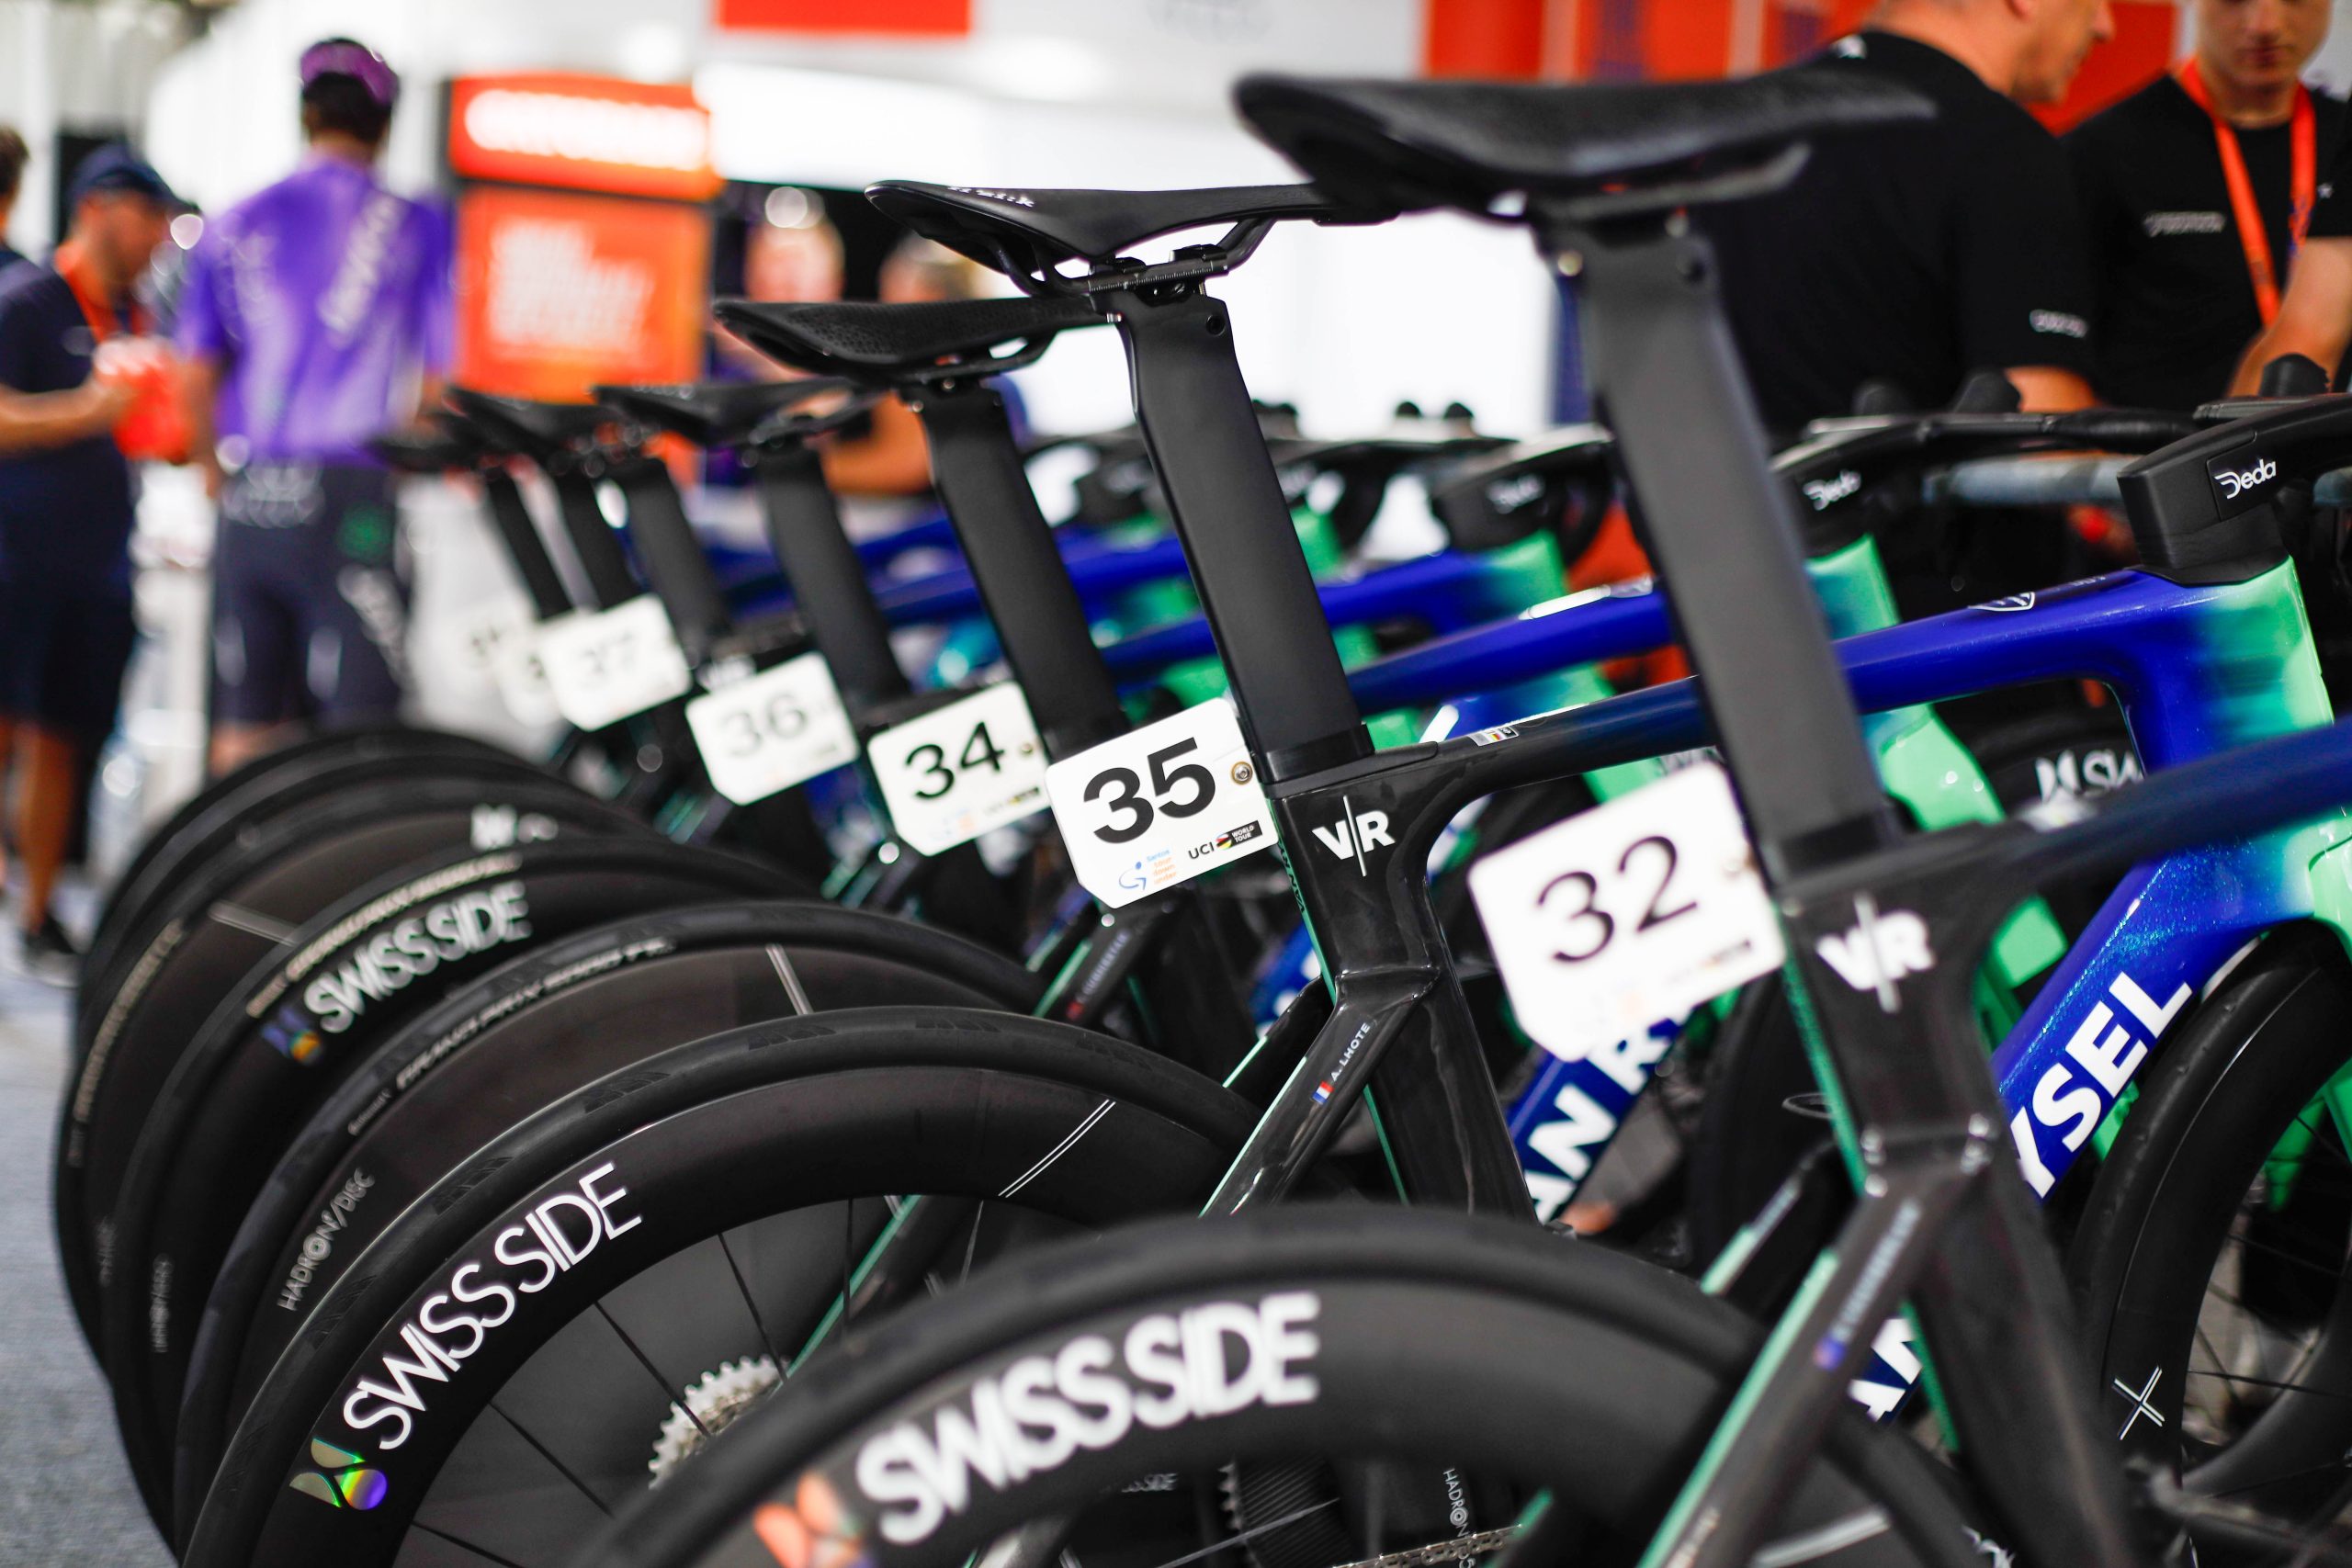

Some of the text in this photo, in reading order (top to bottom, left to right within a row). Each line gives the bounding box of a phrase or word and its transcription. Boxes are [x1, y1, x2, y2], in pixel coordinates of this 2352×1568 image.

[2213, 458, 2277, 500] Deda
[721, 691, 807, 757] 36
[905, 721, 1004, 800] 34
[1083, 737, 1216, 844] 35
[1188, 841, 1215, 860] UCI
[1231, 825, 1254, 838] WORLD
[1235, 832, 1251, 843] TOUR
[1535, 834, 1699, 964] 32
[304, 918, 439, 1033] SWISS
[425, 880, 535, 962] SIDE
[1331, 1022, 1371, 1082] A. LHOTE
[343, 1264, 514, 1451] SWISS
[494, 1162, 642, 1294] SIDE
[855, 1290, 1321, 1546] SWISS SIDE
